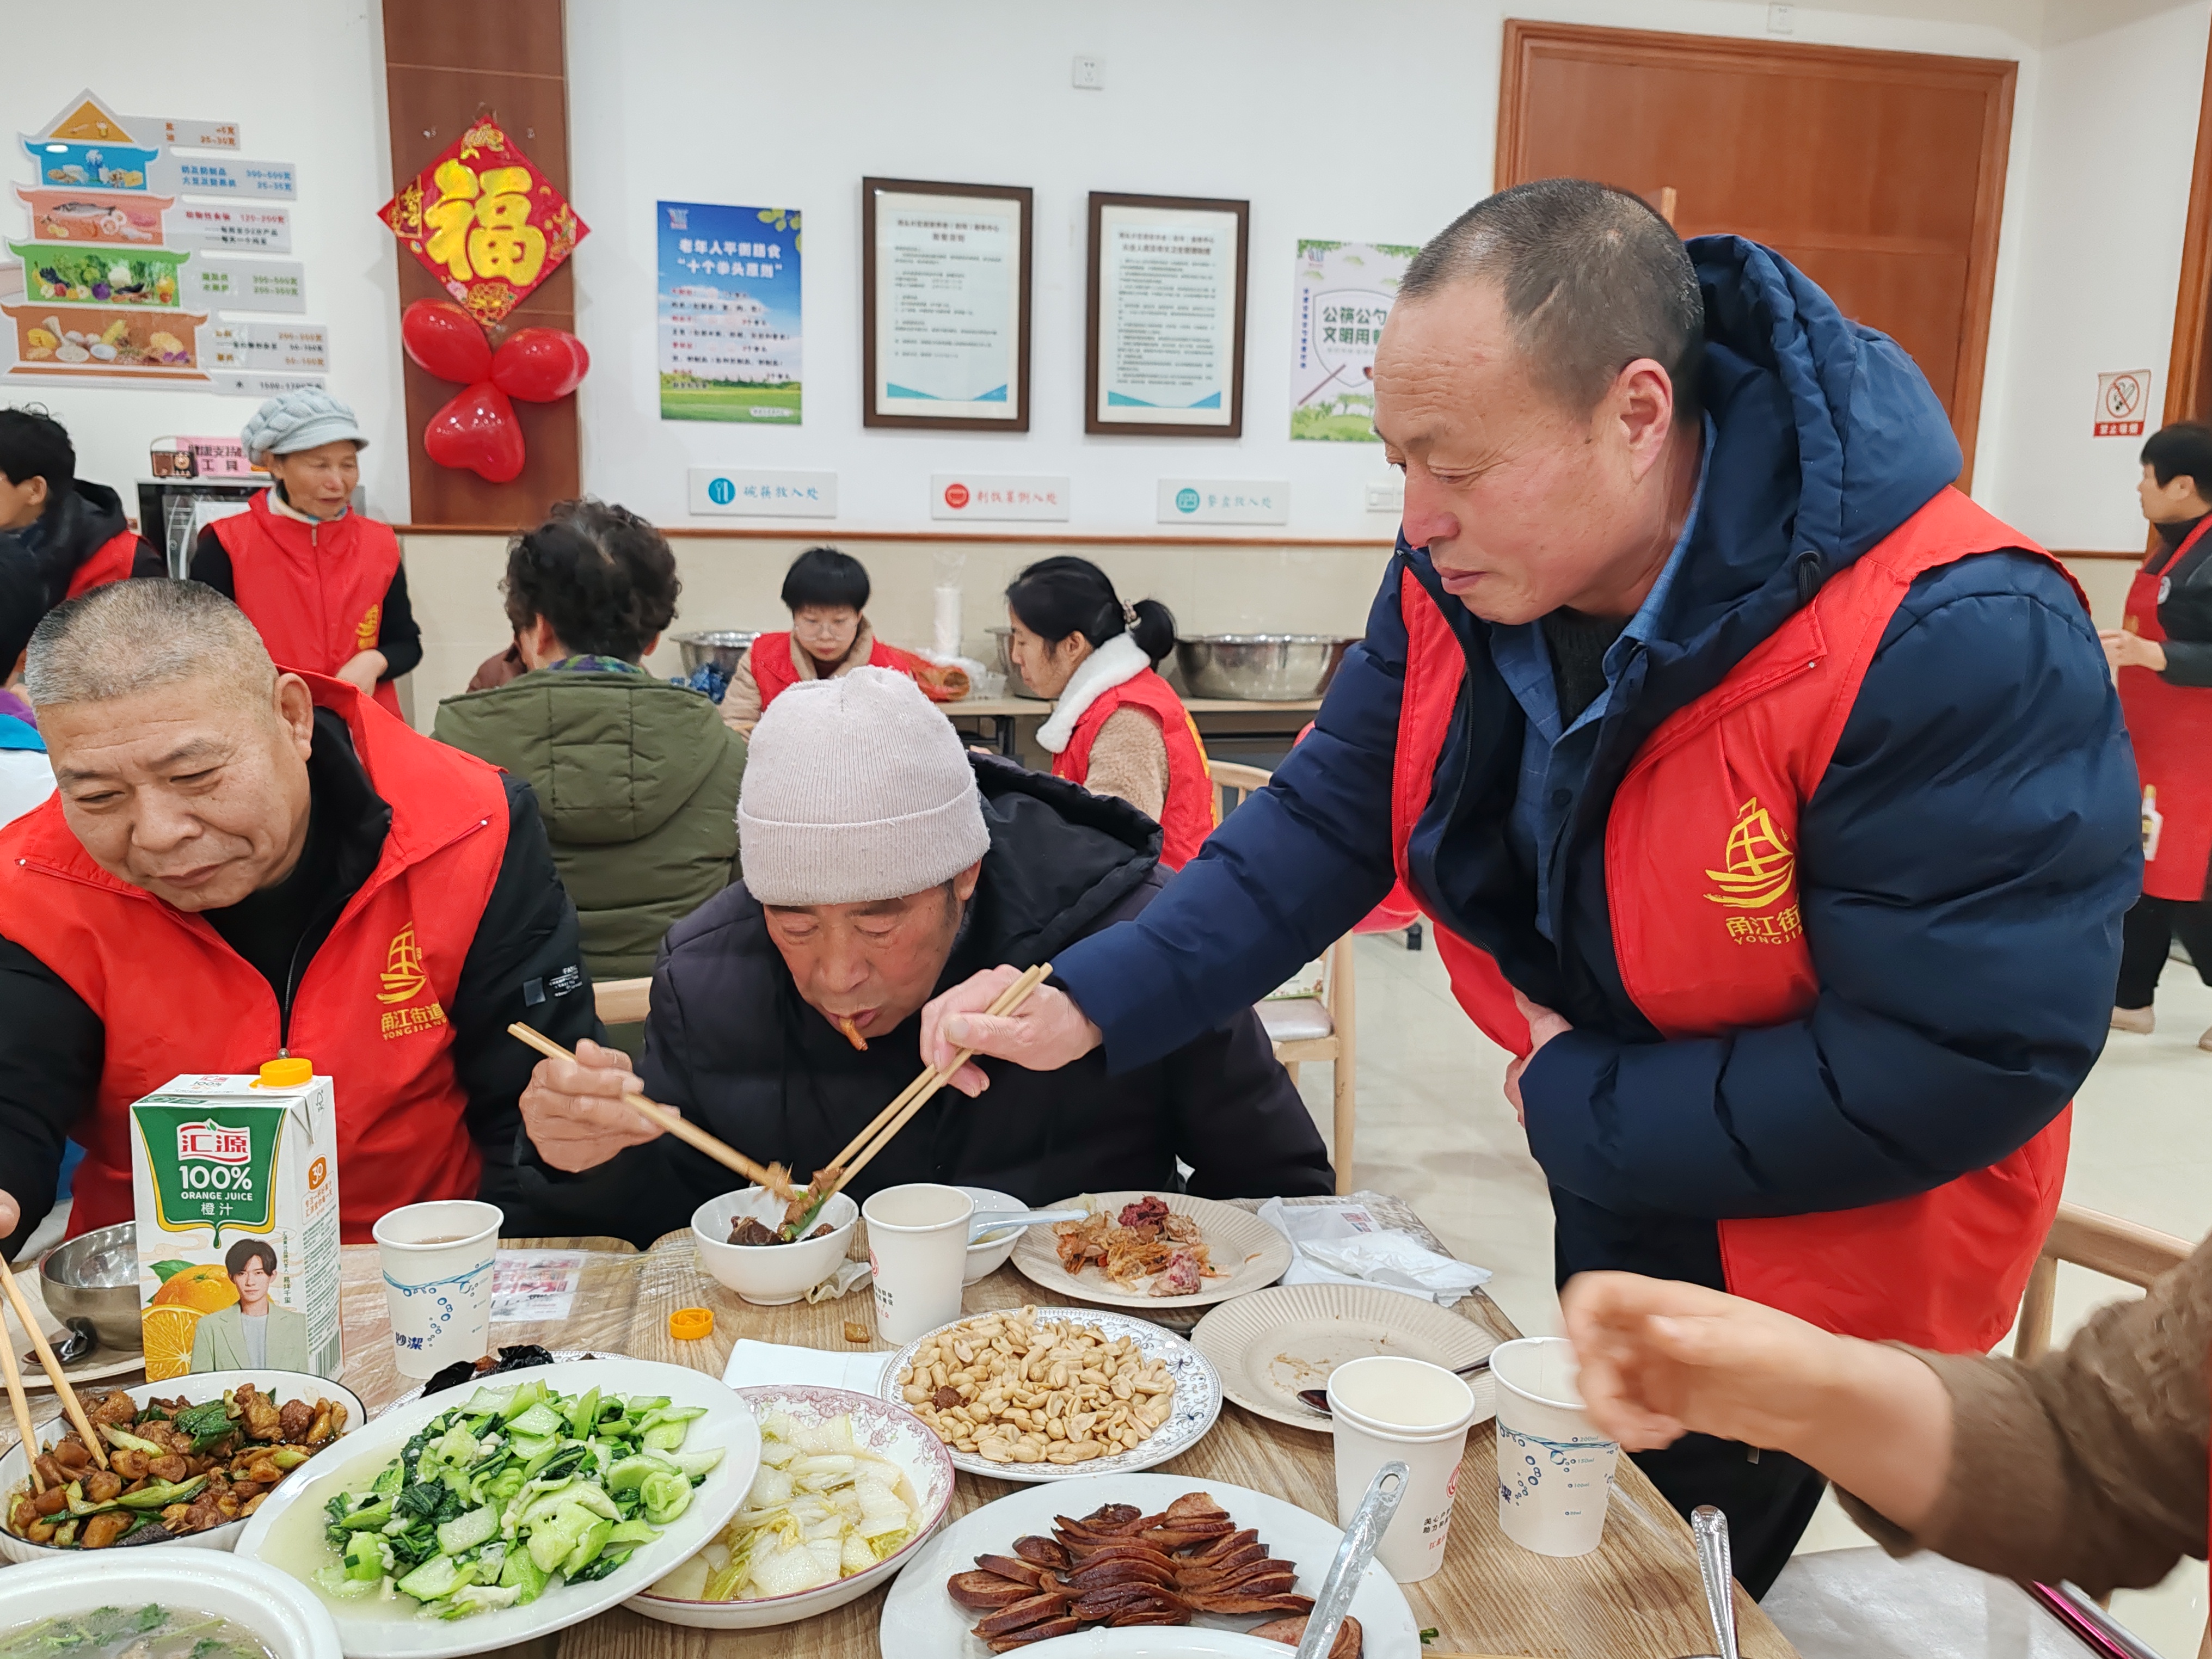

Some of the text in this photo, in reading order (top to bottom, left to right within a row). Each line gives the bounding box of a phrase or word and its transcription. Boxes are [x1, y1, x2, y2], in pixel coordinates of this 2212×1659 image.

[424, 158, 546, 286] 福
[1323, 306, 1387, 326] 公筷公勺
[202, 459, 238, 471] 工具
[382, 1001, 445, 1033] 甬江街道
[181, 1135, 248, 1153] 汇源
[179, 1165, 253, 1190] 100%
[181, 1191, 253, 1201] ORANGE JUICE
[201, 1202, 234, 1216] 橙汁
[1423, 1513, 1451, 1533] 助力和
[1424, 1504, 1452, 1526] 关心户
